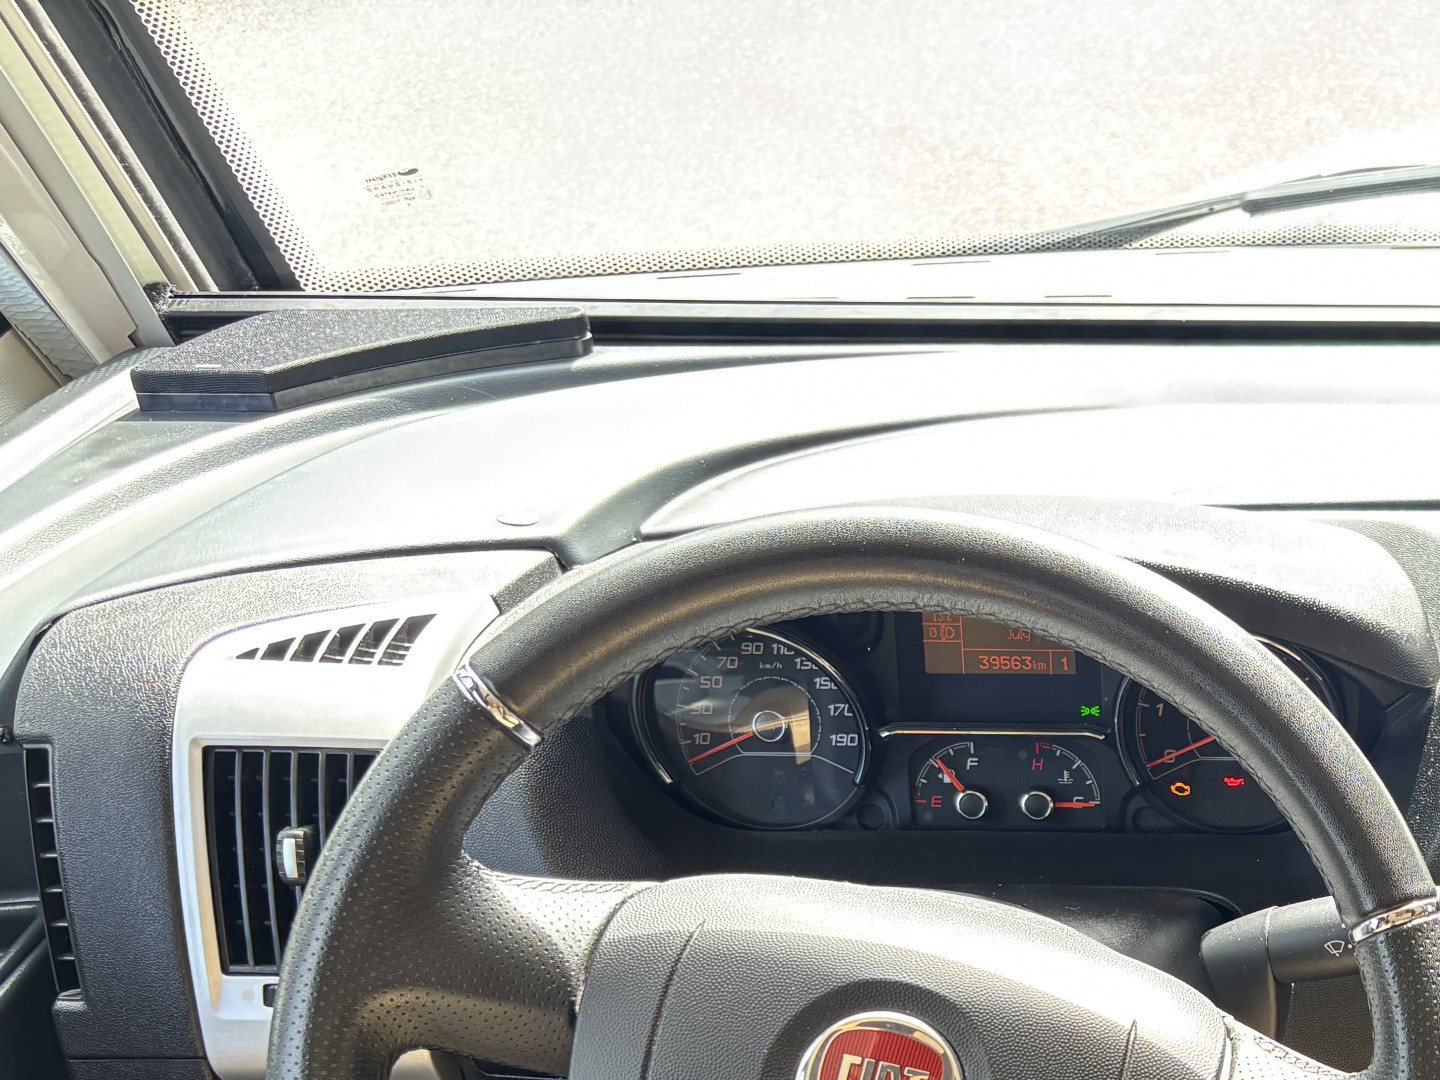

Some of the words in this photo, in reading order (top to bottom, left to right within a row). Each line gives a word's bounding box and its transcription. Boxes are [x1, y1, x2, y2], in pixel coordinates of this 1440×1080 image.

[1008, 628, 1032, 642] July
[741, 642, 764, 655] 90
[717, 656, 739, 669] 70
[759, 661, 783, 670] km/h
[1061, 656, 1069, 671] 1
[700, 675, 723, 689] 50
[1156, 703, 1164, 717] 1
[693, 732, 711, 745] 10
[829, 734, 859, 747] 190
[966, 757, 979, 770] F
[1032, 758, 1044, 771] H
[931, 795, 943, 808] E
